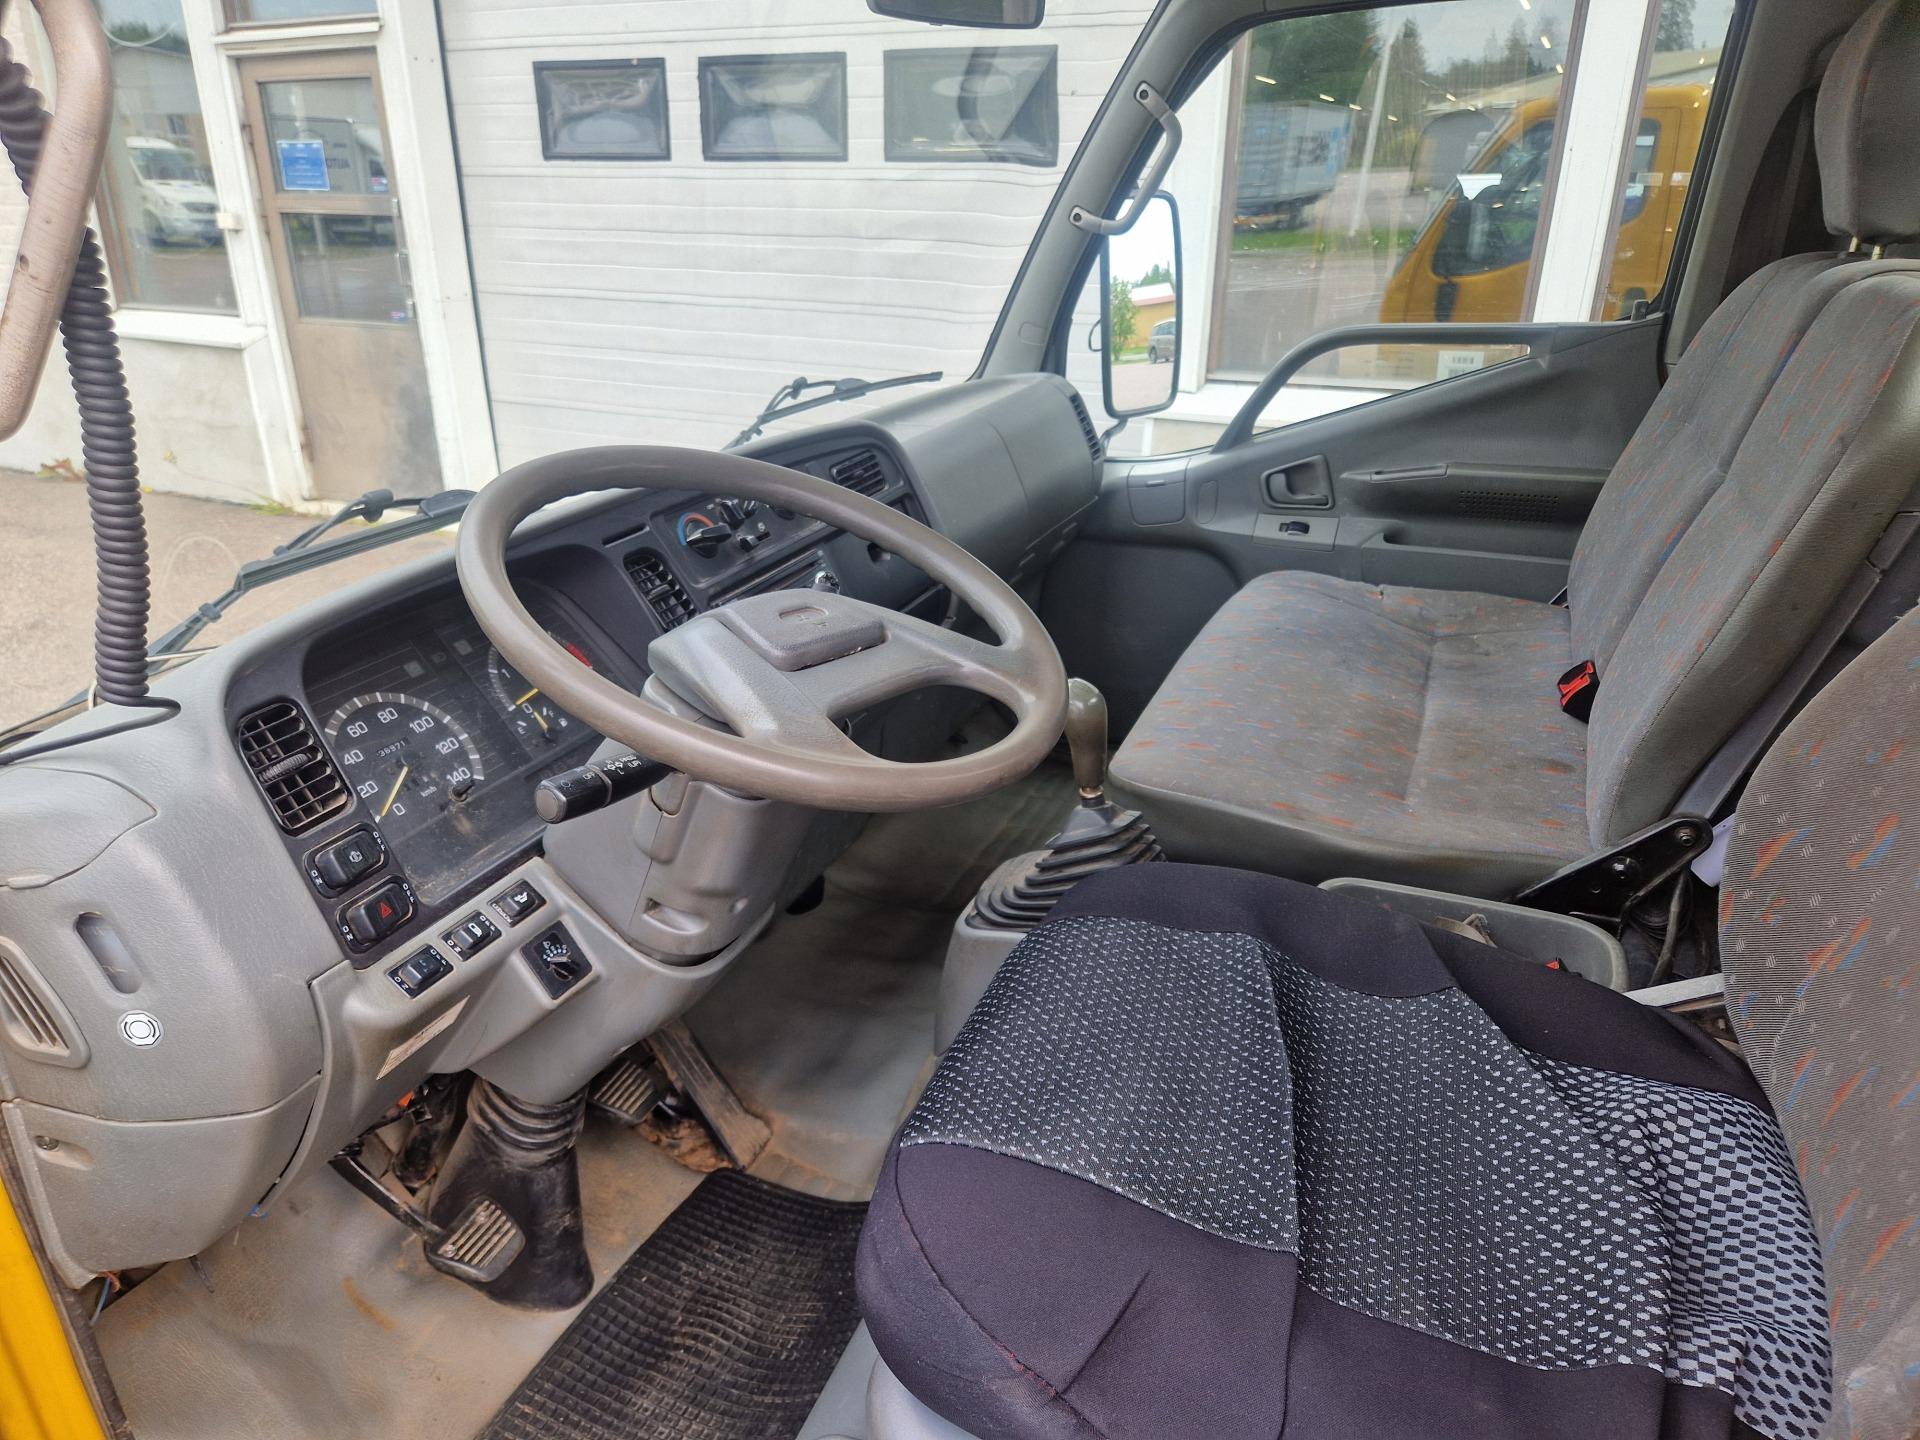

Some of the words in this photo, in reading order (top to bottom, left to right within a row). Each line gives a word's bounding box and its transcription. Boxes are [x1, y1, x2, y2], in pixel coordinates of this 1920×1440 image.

[377, 707, 398, 724] 80
[522, 703, 533, 714] 0
[346, 721, 369, 738] 60
[409, 716, 435, 734] 100
[436, 737, 460, 755] 120
[343, 749, 364, 766] 40
[446, 767, 471, 785] 140
[357, 780, 379, 799] 20
[392, 803, 406, 816] 0
[373, 831, 386, 851] OFF
[311, 869, 323, 885] ON
[402, 883, 415, 904] OFF
[479, 915, 496, 932] OFF
[342, 925, 354, 941] ON
[430, 948, 447, 965] OFF
[394, 976, 409, 990] ON
